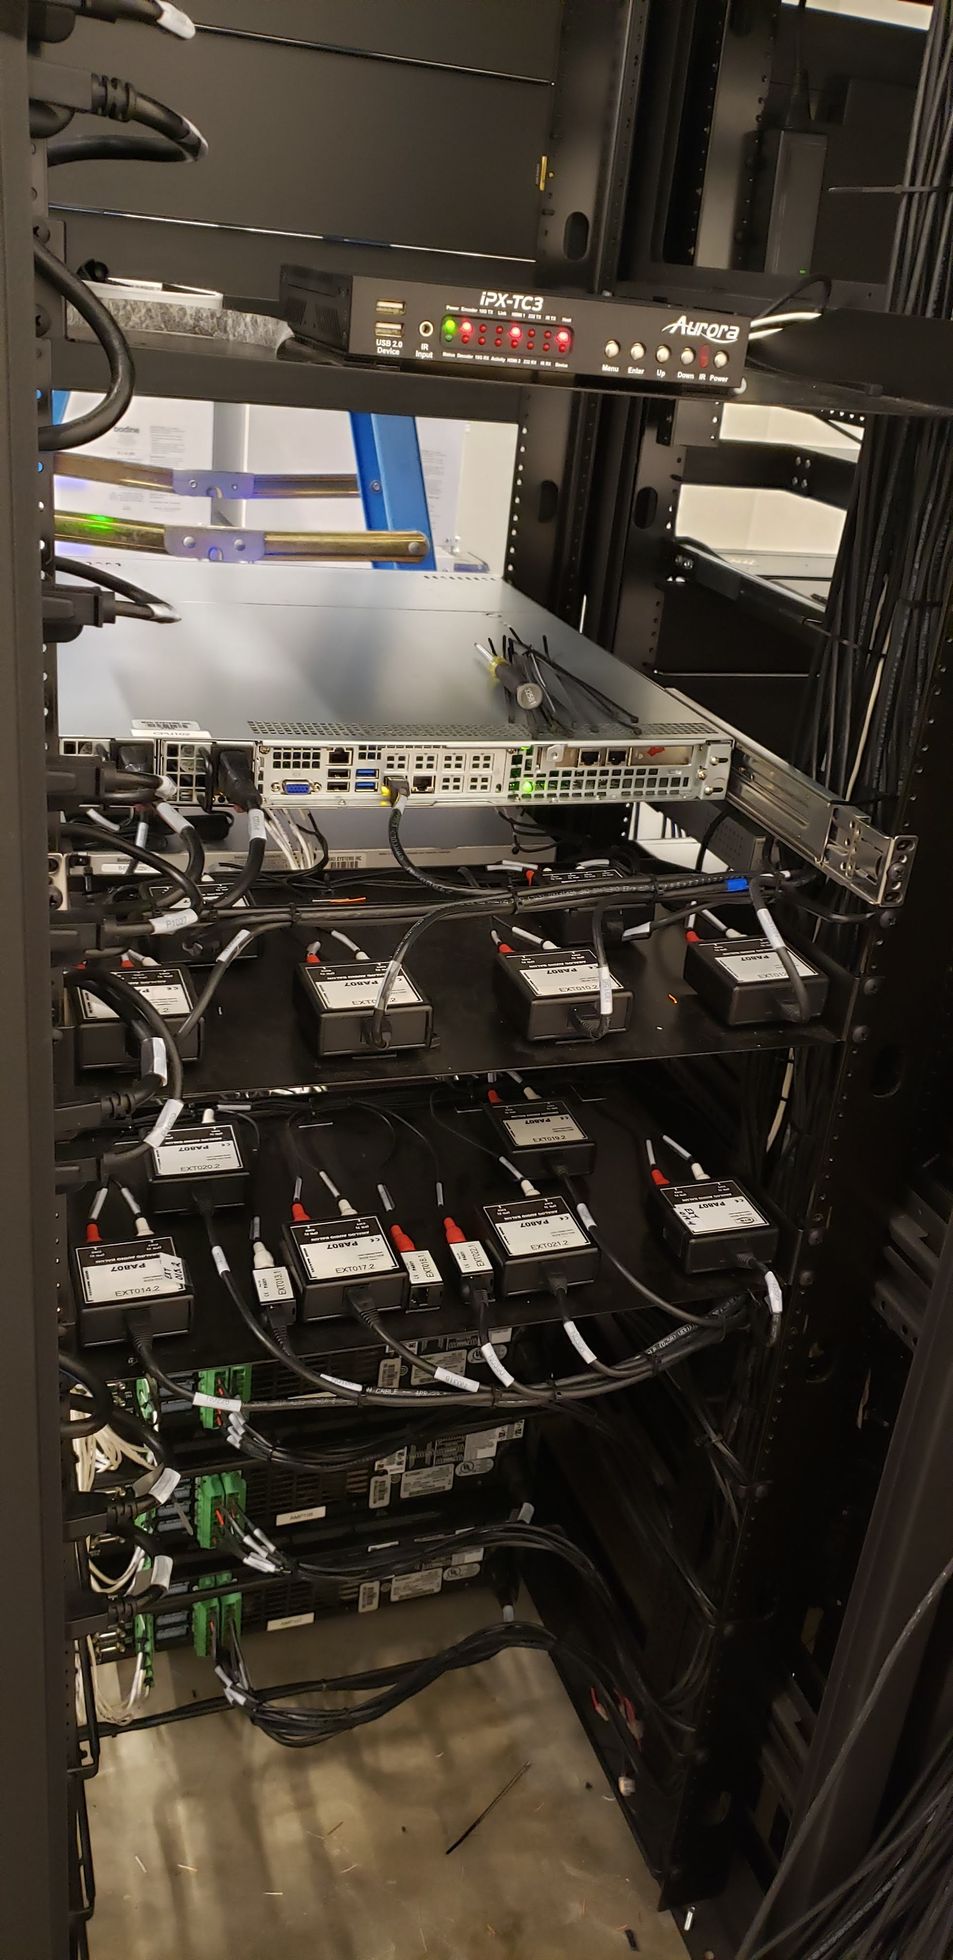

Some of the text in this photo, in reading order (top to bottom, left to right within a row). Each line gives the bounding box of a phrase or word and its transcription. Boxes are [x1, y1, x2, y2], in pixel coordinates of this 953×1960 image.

[480, 291, 544, 311] iPX-TC3
[661, 315, 740, 343] Aurora
[375, 339, 391, 348] USB
[420, 343, 429, 351] IR
[376, 346, 400, 356] Device
[415, 350, 433, 359] Input
[602, 364, 619, 373] Menu
[628, 367, 645, 375] Enter
[657, 369, 666, 377] Up
[677, 371, 695, 379] Down
[709, 374, 728, 382] Power
[180, 1163, 221, 1172] EXT020.2
[520, 1219, 550, 1228] PA807
[327, 1241, 359, 1250] PA807
[530, 1240, 569, 1251] EXT021.2
[111, 1263, 146, 1272] PA807
[335, 1263, 375, 1274] EXT017.2
[273, 1270, 287, 1296] EXT013.1
[114, 1285, 160, 1297] EXT014.2
